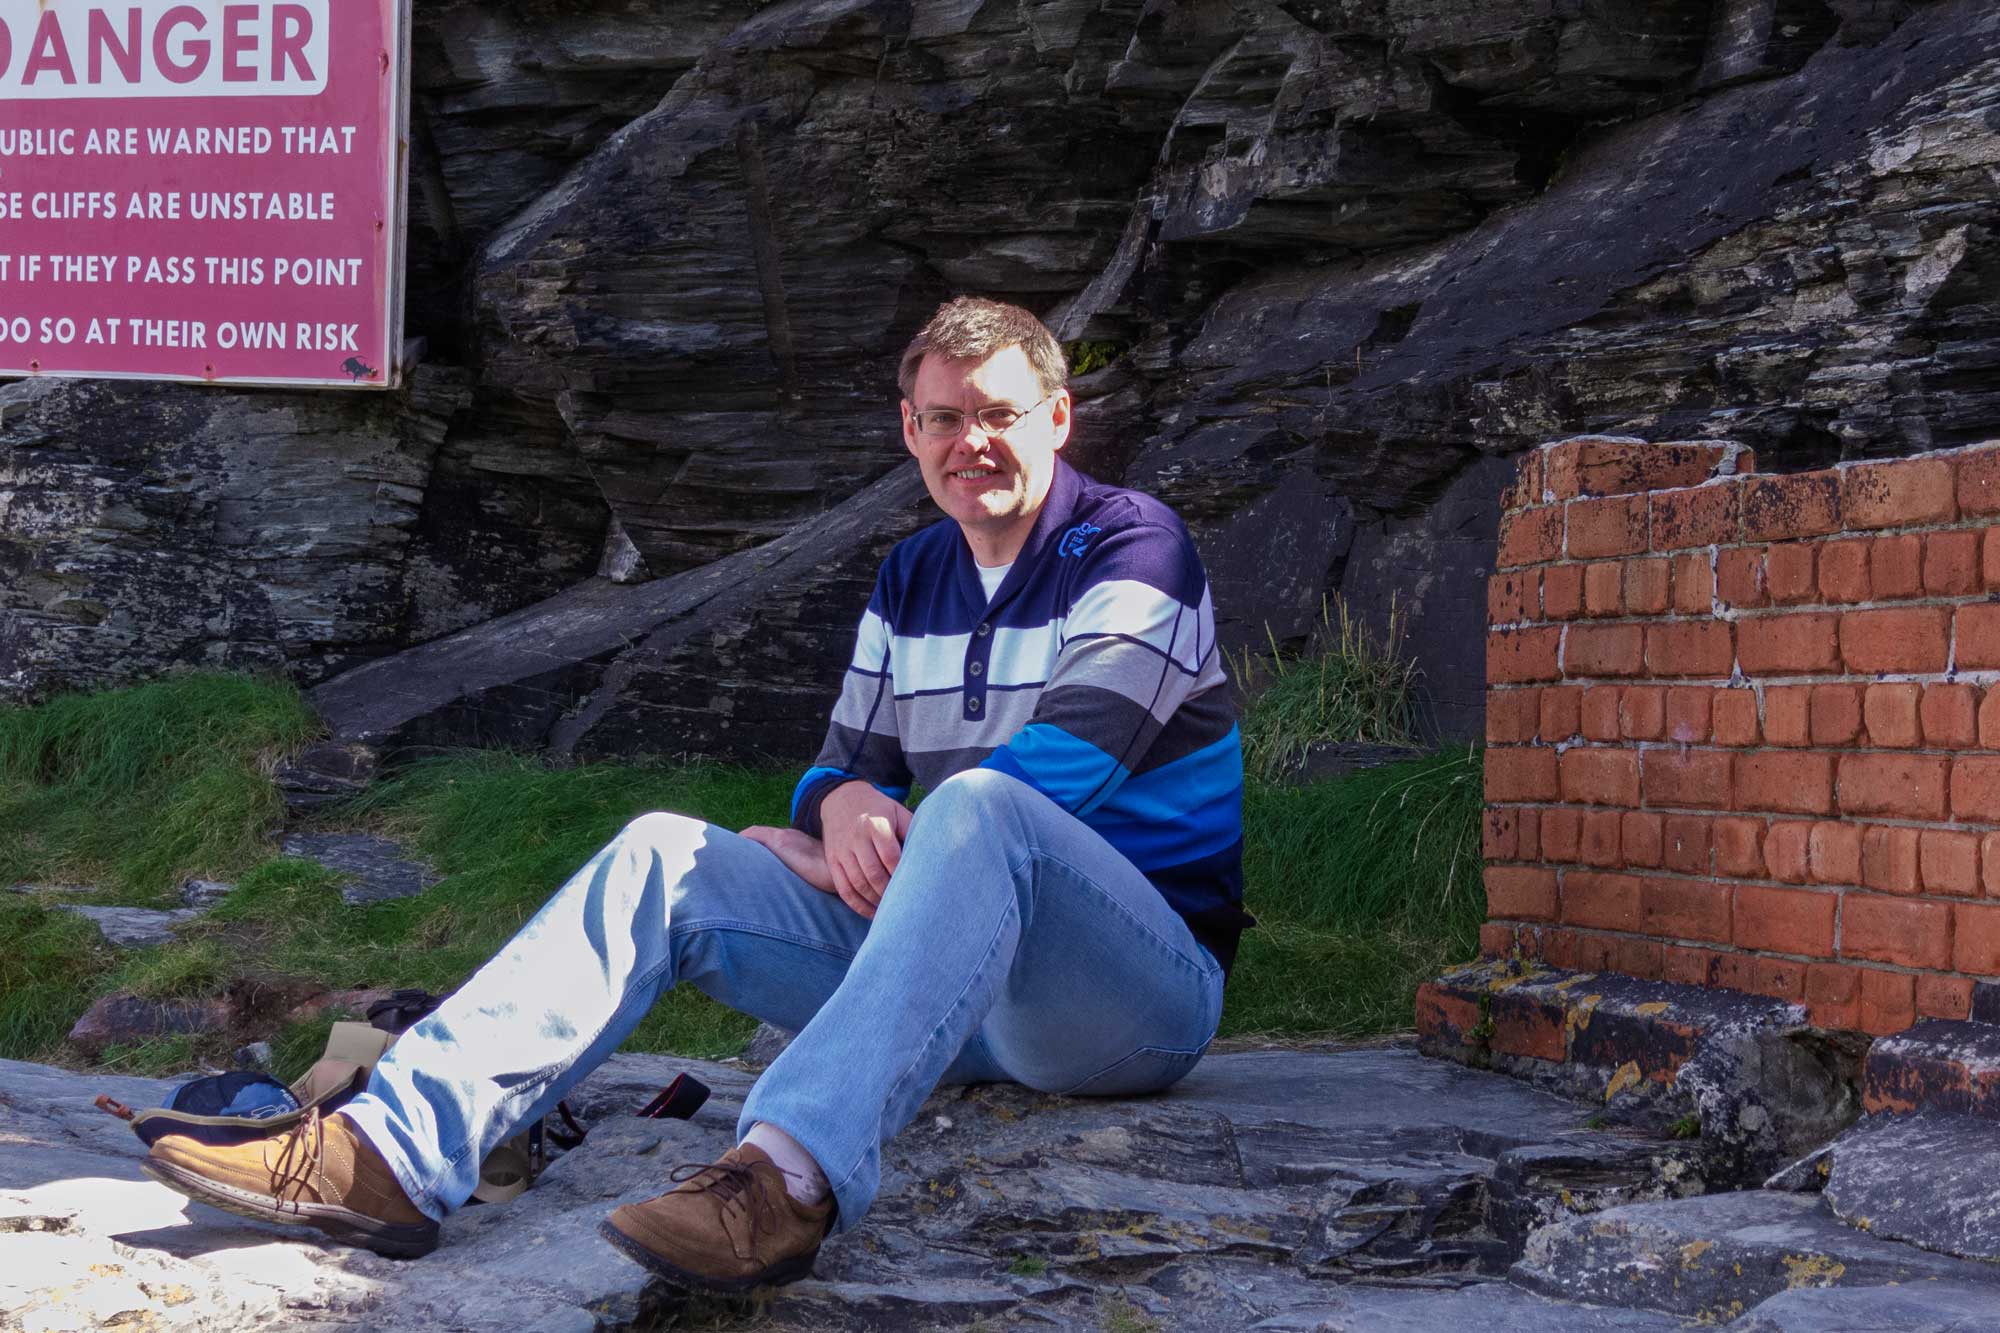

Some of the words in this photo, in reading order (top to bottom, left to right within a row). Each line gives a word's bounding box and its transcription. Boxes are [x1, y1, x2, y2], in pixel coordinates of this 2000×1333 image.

[0, 5, 317, 86] ANGER
[83, 128, 138, 155] ARE
[146, 127, 272, 155] WARNED
[281, 126, 357, 154] THAT
[31, 191, 117, 219] CLIFFS
[125, 192, 181, 219] ARE
[190, 192, 334, 220] UNSTABLE
[19, 255, 41, 282] IF
[49, 255, 118, 282] THEY
[127, 255, 196, 284] PASS
[204, 257, 265, 285] THIS
[274, 257, 363, 286] POINT
[39, 317, 76, 344] SO
[84, 318, 121, 345] AT
[129, 318, 207, 349] THEIR
[216, 321, 287, 349] OWN
[296, 322, 359, 352] RISK
